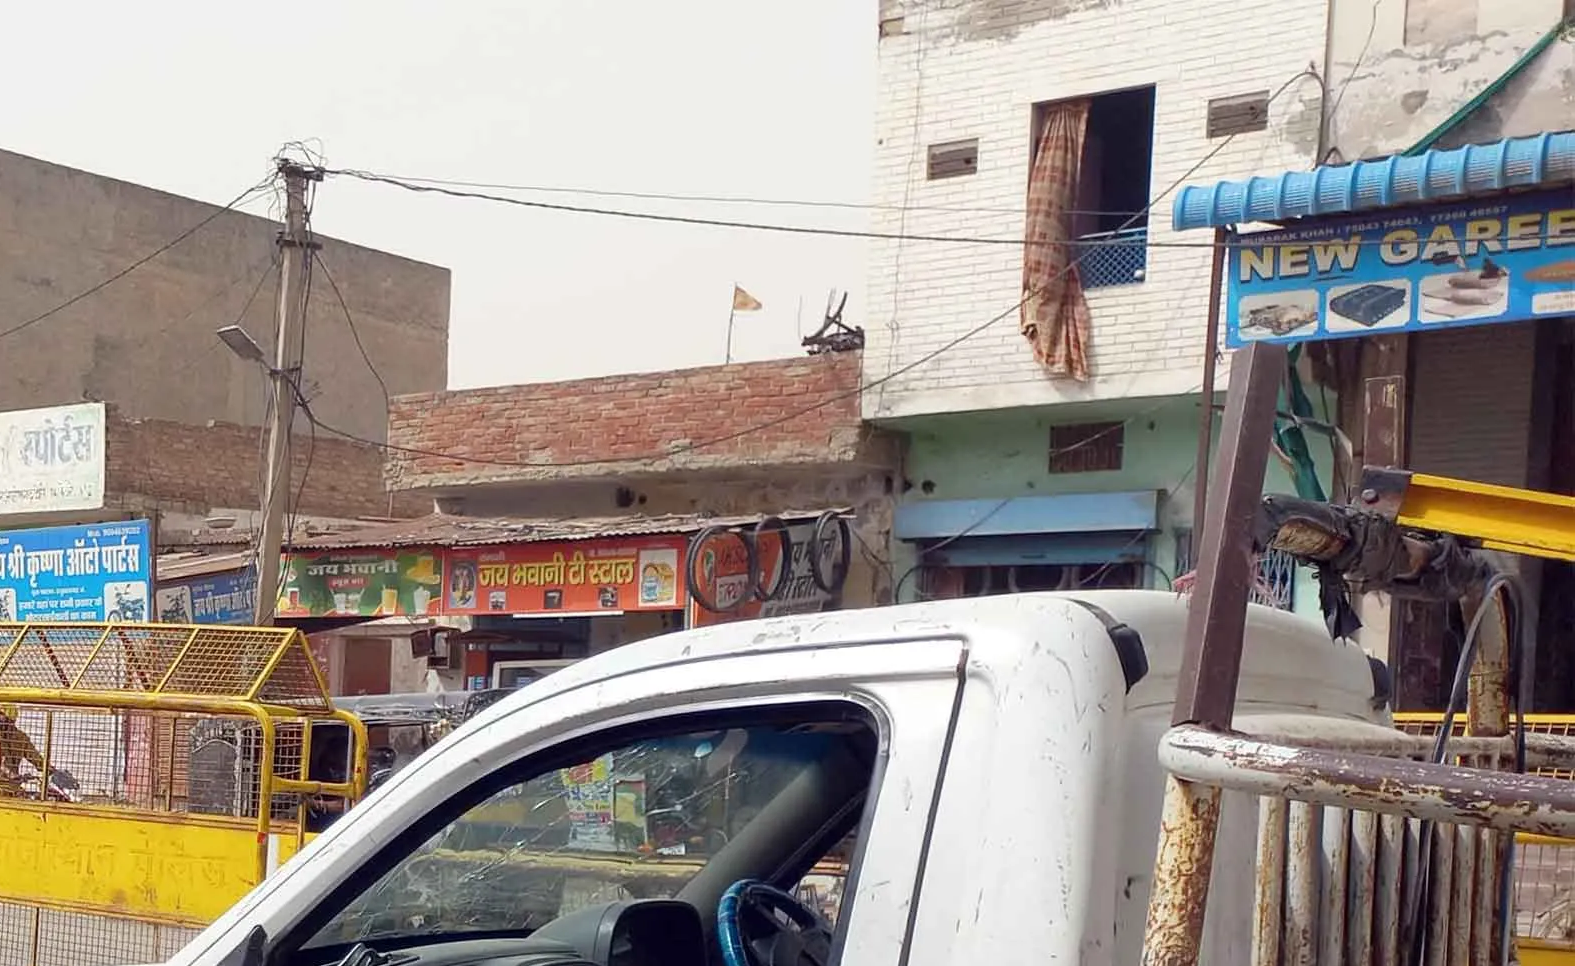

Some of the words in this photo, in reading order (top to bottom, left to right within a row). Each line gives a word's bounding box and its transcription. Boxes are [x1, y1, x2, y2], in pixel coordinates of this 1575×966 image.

[1239, 235, 1363, 283] NEW
[1379, 208, 1575, 266] GAREE
[7, 543, 26, 580] श्री
[307, 563, 339, 577] जय
[479, 563, 509, 587] जय
[512, 551, 565, 586] भवानी
[567, 551, 586, 586] टी
[588, 557, 636, 585] स्टाल
